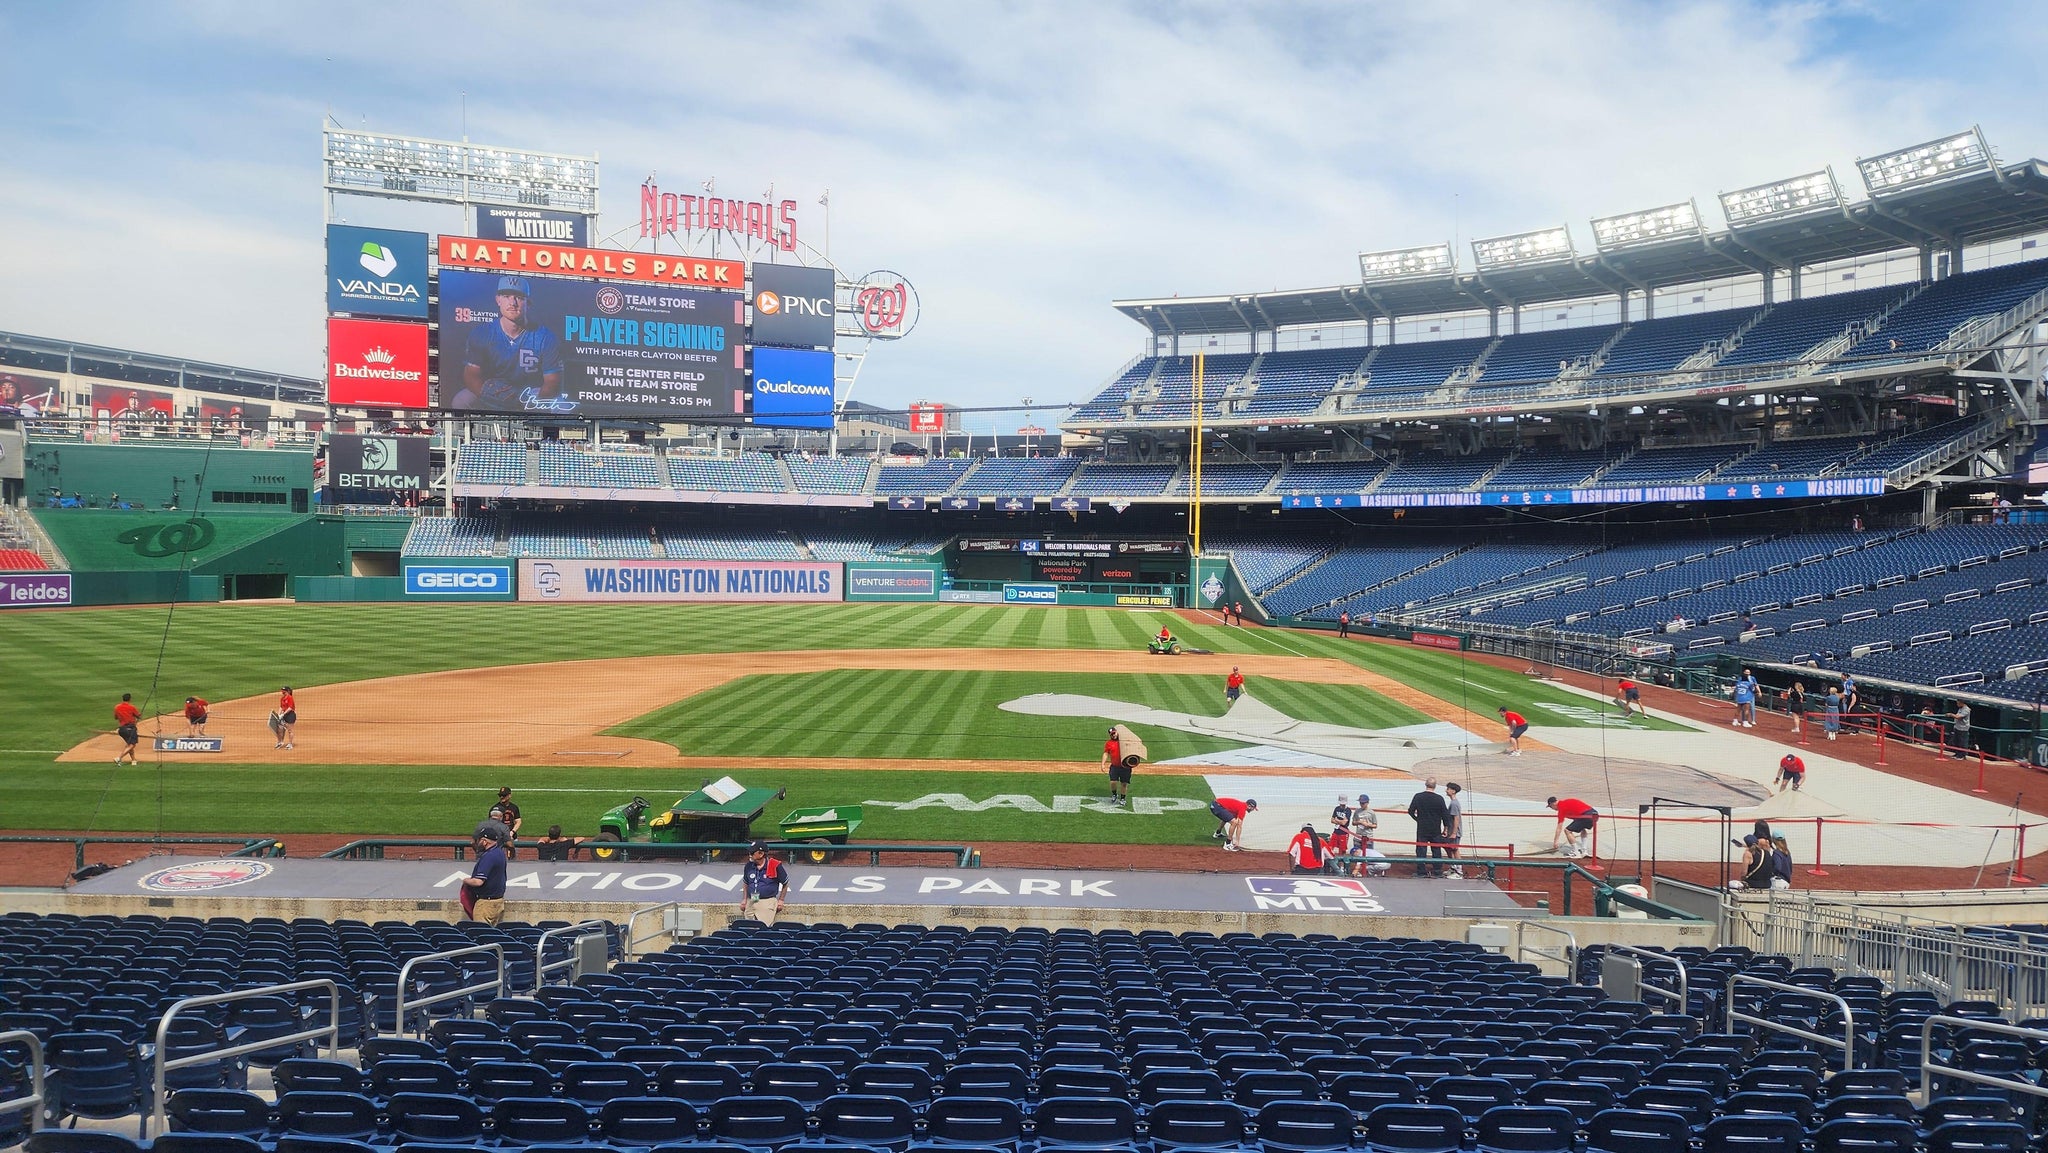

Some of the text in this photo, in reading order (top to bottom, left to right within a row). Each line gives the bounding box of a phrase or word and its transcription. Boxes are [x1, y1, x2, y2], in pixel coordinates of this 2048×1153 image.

[490, 209, 516, 217] SHOW
[641, 184, 797, 252] NATIONALS
[505, 218, 574, 239] NATITUDE
[450, 242, 729, 284] NATIONALS PARK
[337, 278, 420, 298] VANDA
[341, 292, 405, 302] PHARMACEUTICALS
[625, 294, 696, 309] TEAM STORE
[782, 295, 832, 317] PNC
[455, 307, 471, 323] 39
[565, 315, 725, 351] PLAYER SIGNING
[576, 346, 718, 363] WITH PITCHER CLAYTON BEETER
[334, 362, 421, 381] Budweiser
[586, 366, 705, 382] IN THE CENTER FIELD
[594, 377, 698, 392] MAIN TEAM STORE
[756, 379, 831, 396] Qualcomm
[578, 391, 612, 401] FROM
[615, 393, 639, 403] 2:45
[641, 395, 658, 404] PM
[669, 396, 694, 406] 3:05
[696, 398, 712, 407] PM
[339, 473, 420, 489] BETMGM
[1360, 493, 1481, 507] WASHINGTON NATIONALS
[1572, 486, 1706, 503] WASHINGTON NATIONALS
[1022, 542, 1037, 551] 2:54
[1098, 543, 1112, 551] PARK
[1038, 559, 1070, 567] Nationals
[1043, 566, 1082, 575] powered by
[417, 572, 497, 588] GEICO
[585, 567, 831, 594] WASHINGTON NATIONALS
[1050, 573, 1076, 581] Verizon
[1102, 569, 1132, 578] verizon
[855, 578, 929, 587] VENTURE GLOBAL
[10, 583, 68, 601] leidos
[1018, 590, 1056, 599] DABOS
[1164, 587, 1172, 595] 335
[1118, 596, 1171, 605] HERCULES FENCE
[866, 793, 1207, 815] AARP
[918, 876, 1118, 897] PARK
[1253, 895, 1385, 912] MLB
